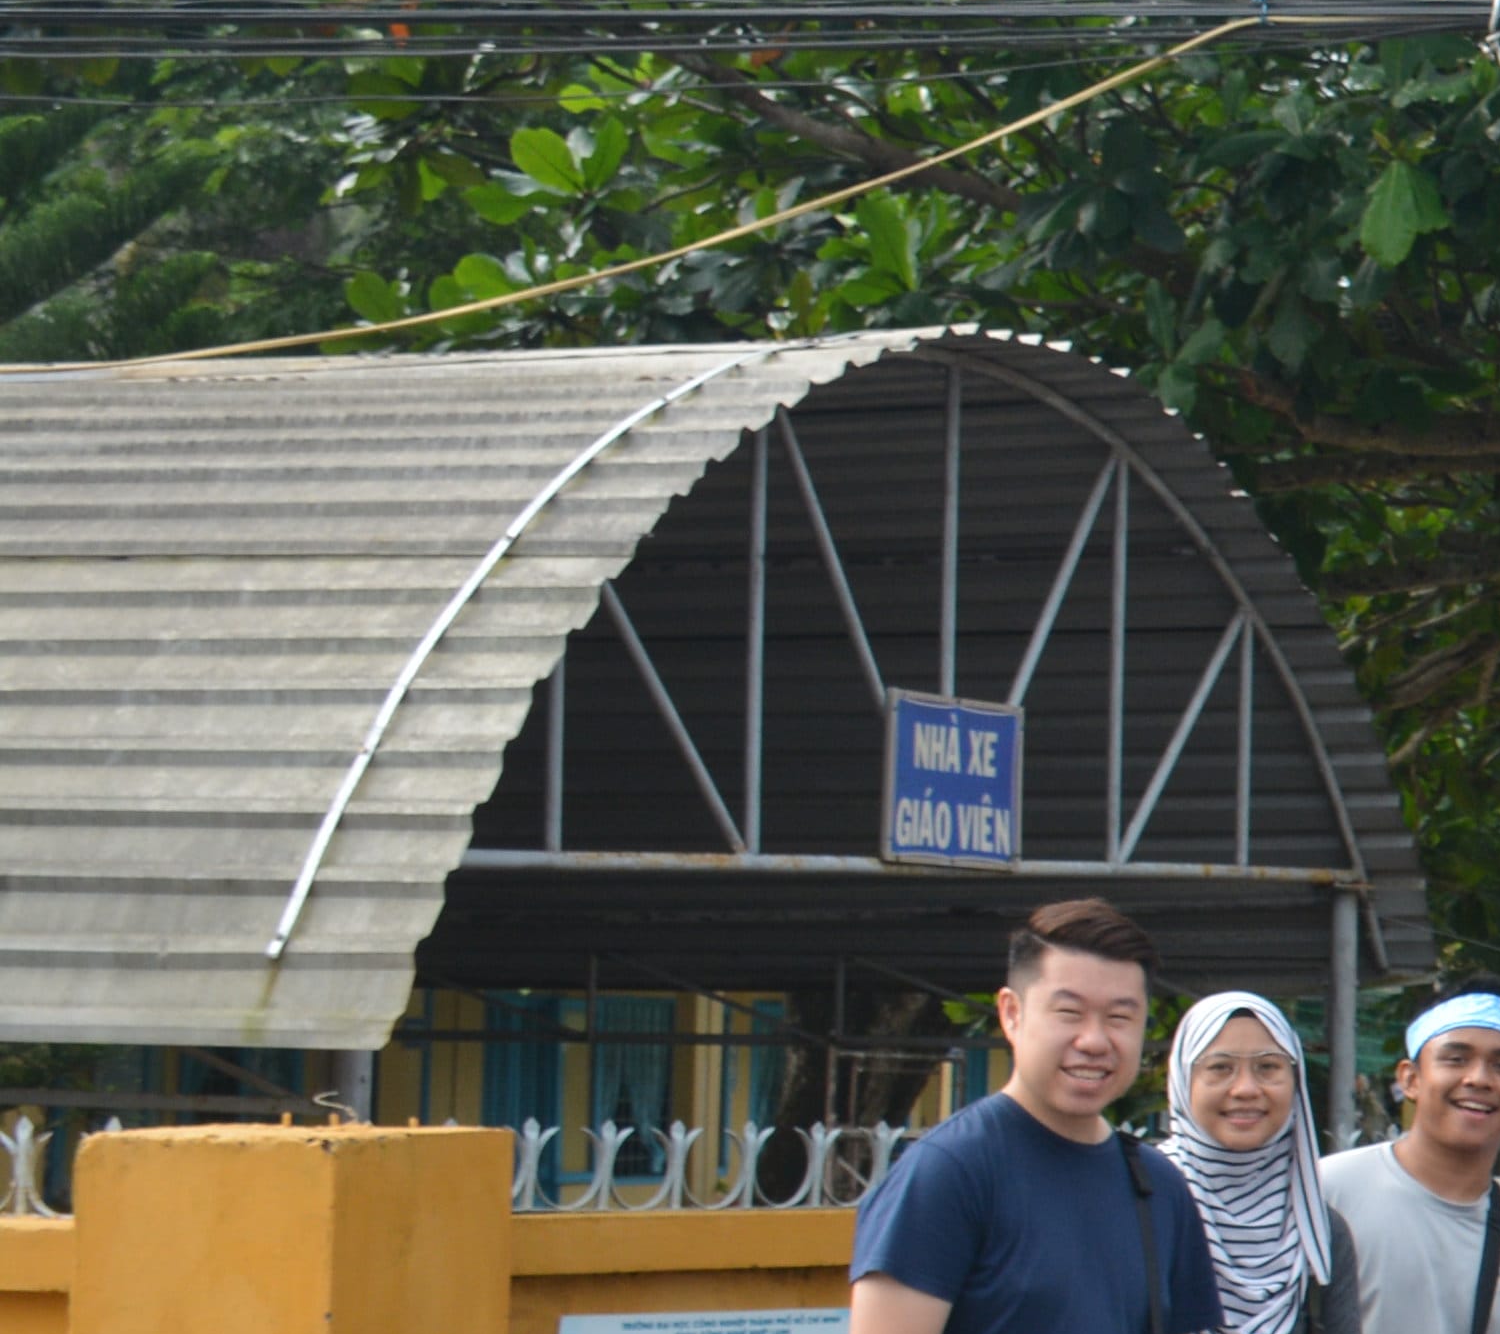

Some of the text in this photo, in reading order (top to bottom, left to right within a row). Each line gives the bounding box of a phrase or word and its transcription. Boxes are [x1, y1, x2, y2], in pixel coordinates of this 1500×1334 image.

[913, 713, 999, 778] NHÀ XE
[895, 787, 1011, 856] GIÁO VIÊN
